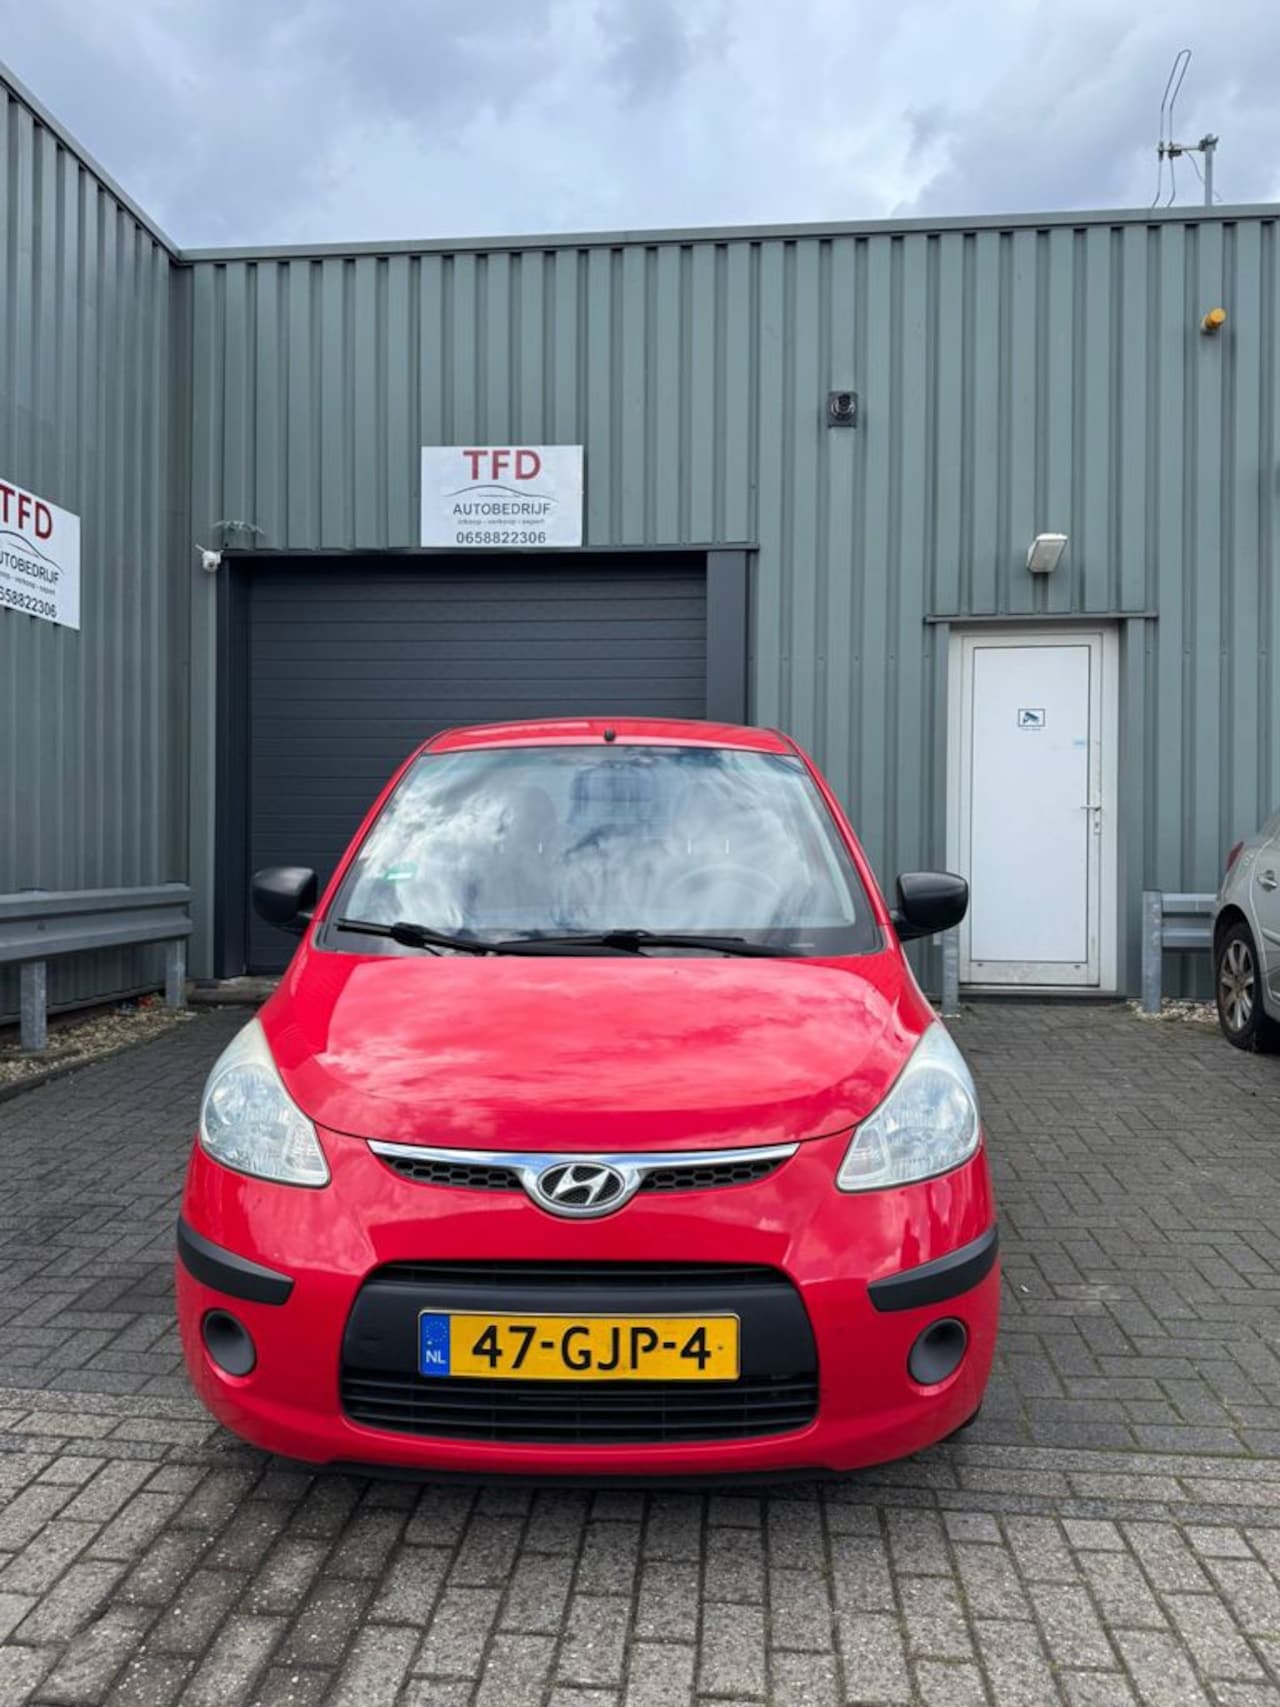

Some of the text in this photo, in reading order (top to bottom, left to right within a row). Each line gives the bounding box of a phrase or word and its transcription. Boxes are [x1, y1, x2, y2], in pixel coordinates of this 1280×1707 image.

[463, 450, 541, 480] TFD
[0, 483, 53, 540] TFD
[453, 503, 551, 515] AUTOBEDRIJF
[456, 531, 546, 544] 0658822306
[426, 1350, 447, 1364] NL
[471, 1325, 712, 1370] 47-GJP-4
